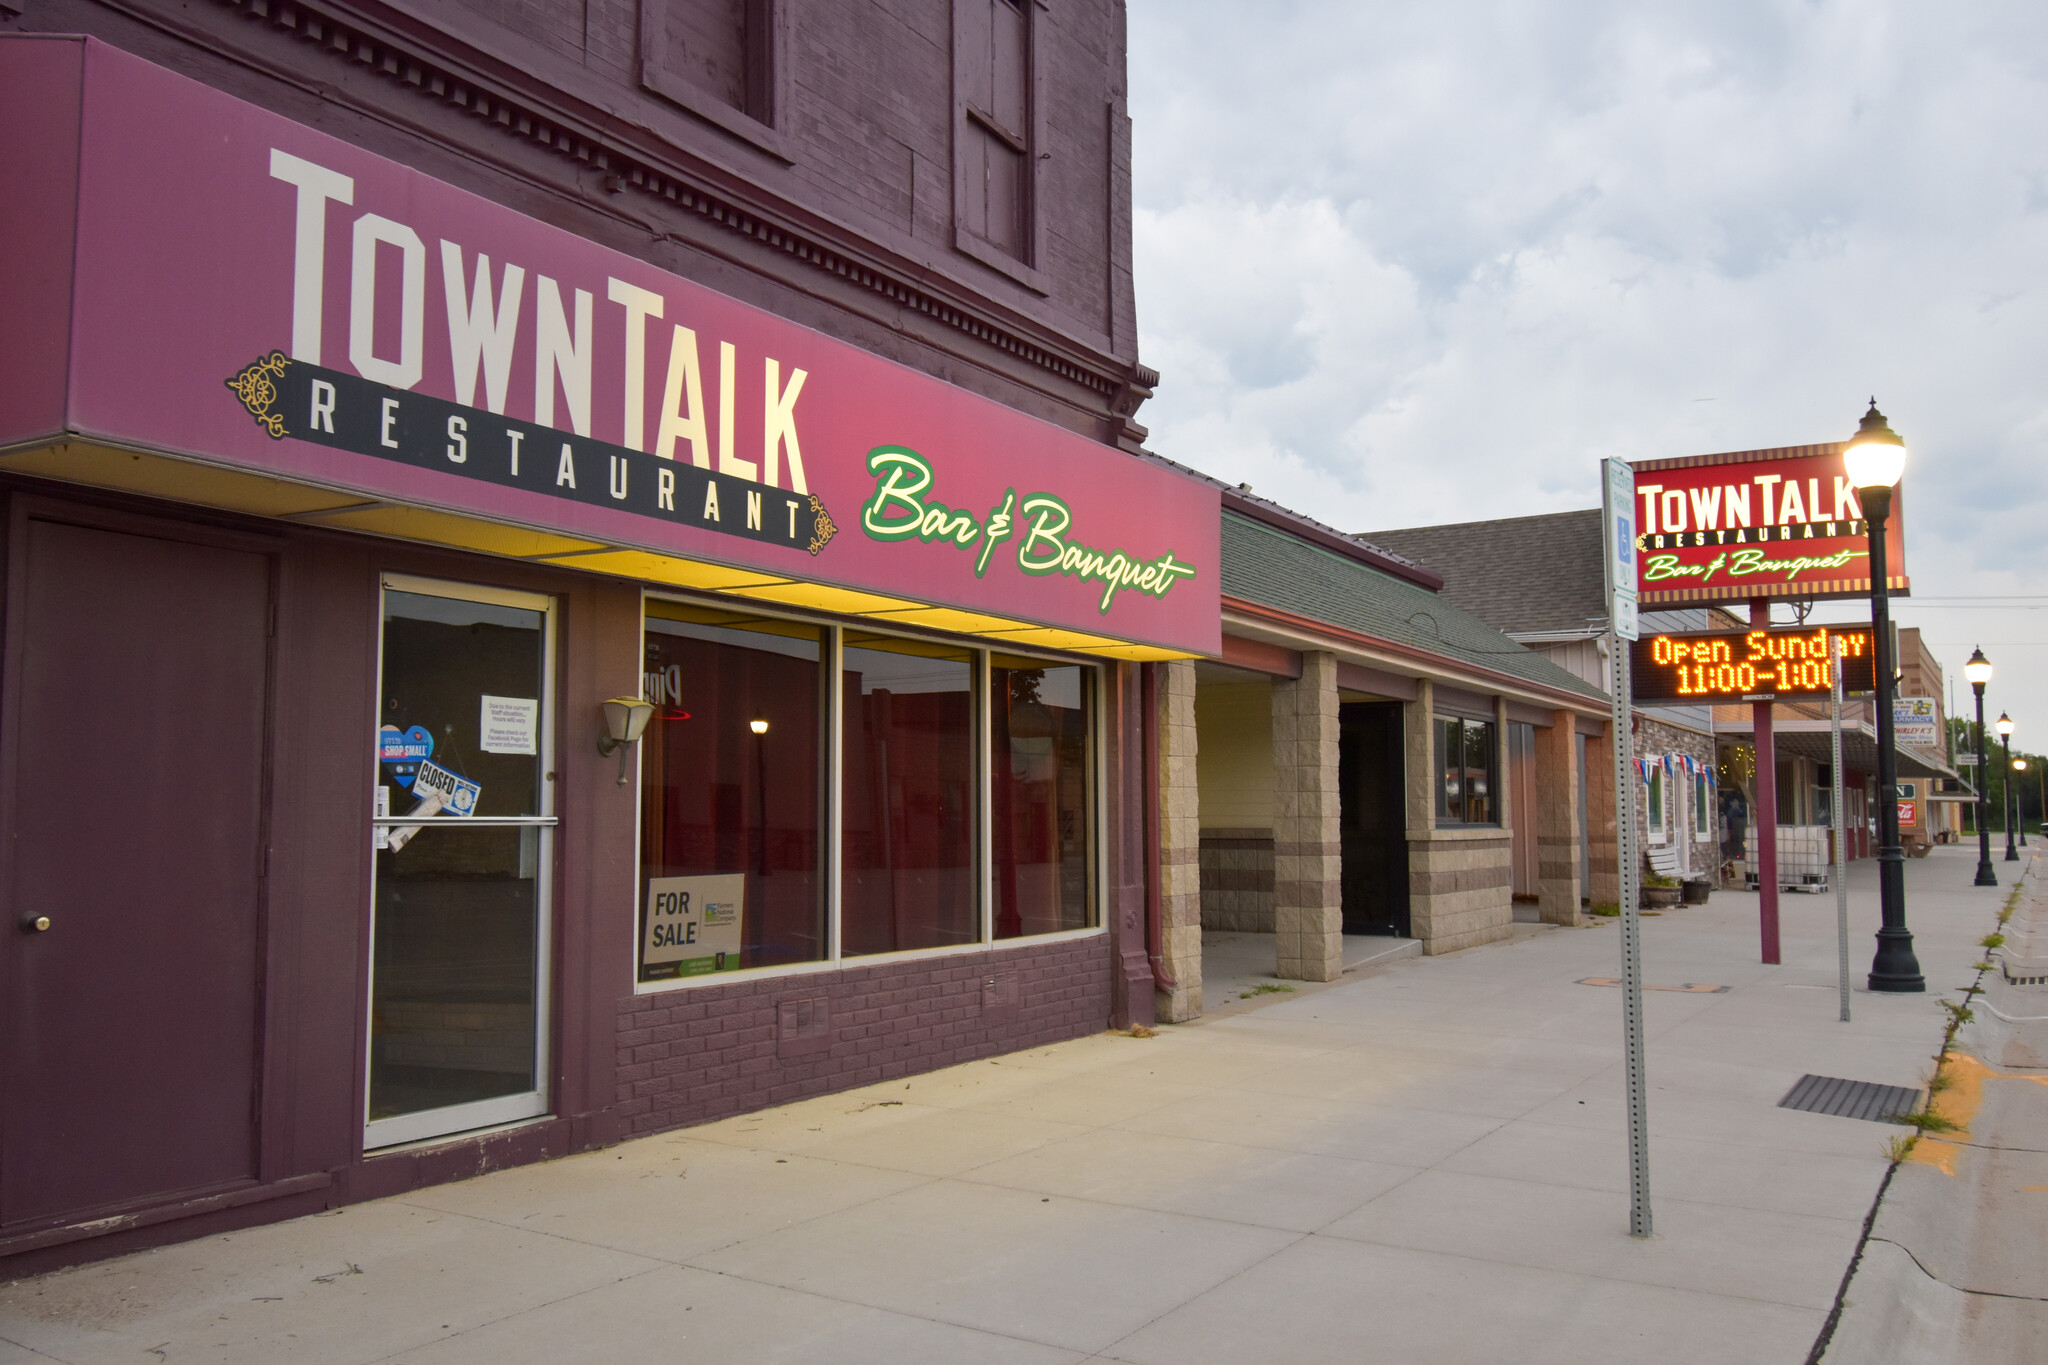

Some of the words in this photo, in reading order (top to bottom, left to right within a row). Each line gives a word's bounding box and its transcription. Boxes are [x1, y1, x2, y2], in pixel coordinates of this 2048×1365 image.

[311, 378, 800, 539] RESTAURANT
[862, 447, 979, 547] Bar
[977, 490, 1015, 575] &
[1018, 494, 1195, 612] Banquet
[1655, 521, 1858, 549] RESTAURANT
[1645, 554, 1705, 580] Bar
[1703, 553, 1727, 582] &
[1729, 548, 1869, 580] Banquet
[1653, 635, 1730, 665] Open
[1894, 727, 1919, 735] HIRLEY
[384, 744, 404, 757] SHOP
[404, 744, 428, 757] SMALL
[419, 762, 456, 796] CLOSED
[655, 891, 690, 916] FOR
[652, 921, 697, 948] SALE
